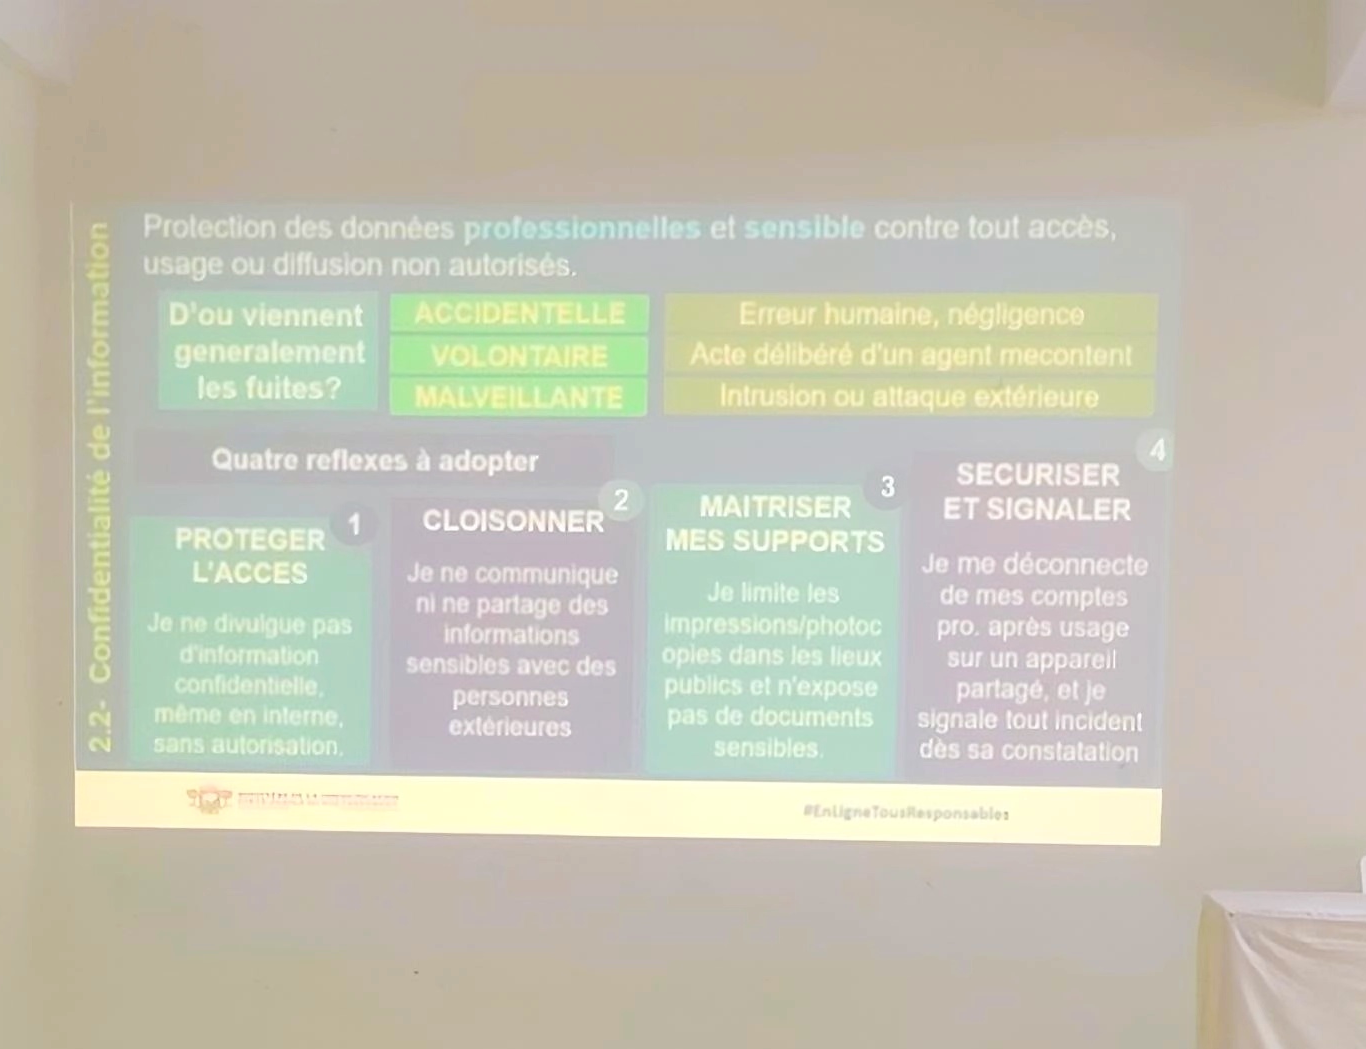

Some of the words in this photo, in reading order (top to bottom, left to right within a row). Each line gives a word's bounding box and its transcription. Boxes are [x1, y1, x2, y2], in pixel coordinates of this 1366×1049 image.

[144, 214, 275, 240] Protection
[284, 214, 333, 240] des
[341, 214, 454, 240] données
[464, 214, 701, 246] professionnelles
[711, 217, 736, 240] et
[745, 215, 865, 240] sensible
[874, 218, 960, 240] contre
[969, 217, 1020, 240] tout
[1028, 215, 1117, 242] accès,
[144, 257, 223, 281] usage
[232, 257, 265, 277] ou
[273, 253, 382, 277] diffusion
[392, 257, 439, 277] non
[449, 255, 577, 277] autorisés.
[86, 222, 111, 415] l'information
[169, 303, 233, 326] D'ou
[243, 303, 363, 326] viennent
[415, 303, 625, 324] ACCIDENTELLE
[740, 303, 815, 325] Erreur
[825, 303, 939, 329] humaine,
[948, 303, 1084, 331] négligence
[174, 340, 366, 369] generalement
[431, 345, 607, 367] VOLONTAIRE
[691, 344, 745, 366] Acte
[754, 342, 853, 366] délibéré
[862, 343, 913, 366] d'un
[922, 345, 991, 371] agent
[1000, 345, 1132, 367] mecontent
[198, 376, 236, 399] les
[246, 376, 341, 399] fuites?
[415, 387, 623, 409] MALVEILLANTE
[721, 384, 826, 407] Intrusion
[835, 390, 864, 407] ou
[873, 386, 966, 412] attaque
[975, 384, 1098, 409] extérieure
[87, 424, 111, 460] de
[1150, 439, 1165, 460] 4
[212, 449, 298, 472] Quatre
[307, 447, 408, 472] reflexes
[417, 446, 431, 471] à
[439, 448, 538, 476] adopter
[881, 476, 895, 496] 3
[957, 463, 1119, 486] SECURISER
[614, 489, 629, 510] 2
[700, 496, 850, 518] MAITRISER
[944, 498, 980, 520] ET
[988, 498, 1131, 522] SIGNALER
[348, 514, 361, 534] 1
[423, 510, 604, 532] CLOISONNER
[176, 528, 325, 551] PROTEGER
[666, 529, 724, 552] MES
[733, 530, 885, 553] SUPPORTS
[87, 470, 111, 683] Confidentialité
[193, 562, 308, 584] L'ACCES
[407, 563, 432, 583] Je
[441, 568, 467, 583] ne
[475, 564, 618, 588] communique
[922, 555, 949, 575] Je
[957, 559, 996, 575] me
[1004, 554, 1148, 576] déconnecte
[707, 582, 734, 603] Je
[742, 583, 799, 603] limite
[808, 583, 839, 604] les
[941, 586, 968, 606] de
[976, 590, 1023, 606] mes
[1031, 587, 1128, 611] comptes
[416, 596, 435, 613] ni
[443, 598, 468, 614] ne
[477, 597, 560, 619] partage
[569, 596, 608, 615] des
[147, 614, 171, 633] Je
[181, 617, 206, 633] ne
[215, 614, 305, 639] divulgue
[313, 617, 352, 638] pas
[444, 624, 579, 645] informations
[664, 615, 881, 639] impressions/photoc
[937, 620, 980, 642] pro.
[989, 617, 1051, 642] après
[1059, 621, 1129, 643] usage
[180, 646, 318, 666] d'information
[407, 655, 510, 675] sensibles
[518, 660, 568, 675] avec
[577, 657, 616, 677] des
[662, 646, 721, 669] opies
[730, 646, 783, 666] dans
[792, 647, 821, 667] les
[830, 647, 881, 668] lieux
[948, 652, 983, 668] sur
[991, 652, 1018, 668] un
[1026, 648, 1117, 674] appareil
[664, 676, 742, 701] publics
[750, 678, 771, 696] et
[778, 676, 878, 702] n'expose
[957, 680, 1048, 704] partagé,
[1058, 683, 1079, 700] et
[1086, 683, 1105, 705] je
[453, 690, 568, 713] personnes
[155, 706, 221, 725] même
[230, 710, 254, 725] en
[449, 717, 571, 737] extérieures
[668, 709, 707, 730] pas
[715, 706, 742, 727] de
[750, 706, 873, 728] documents
[918, 711, 998, 733] signale
[1006, 713, 1047, 730] tout
[1056, 712, 1143, 733] incident
[714, 737, 823, 758] sensibles.
[920, 739, 960, 760] dès
[968, 743, 993, 760] sa
[1001, 740, 1138, 763] constatation
[804, 804, 1009, 821] #EnLigneTousResponsables
